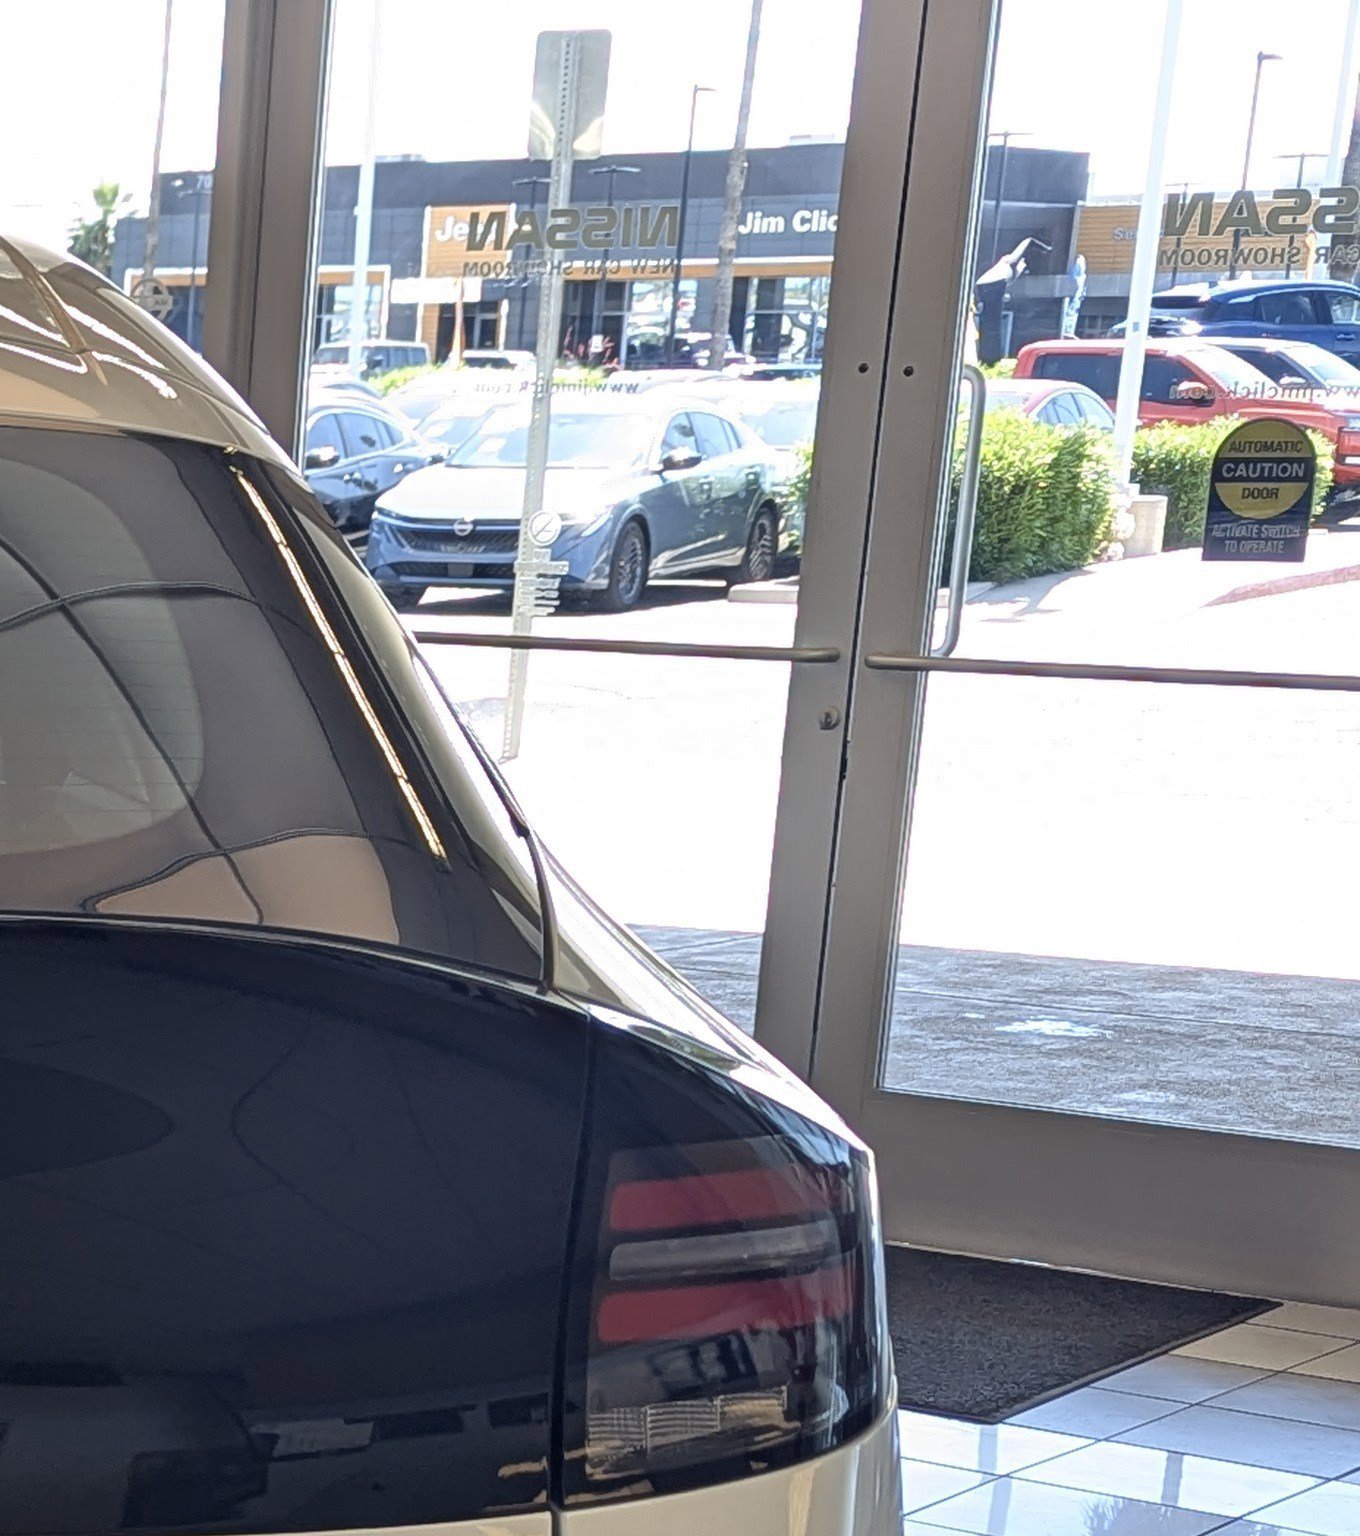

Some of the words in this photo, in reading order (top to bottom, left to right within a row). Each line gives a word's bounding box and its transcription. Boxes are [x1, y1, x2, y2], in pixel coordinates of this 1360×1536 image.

[738, 210, 785, 235] Jim
[1228, 440, 1304, 453] AUTOMATIC
[1221, 462, 1305, 478] CAUTION
[1241, 487, 1280, 500] DOOR
[1212, 523, 1258, 537] ACTIVATE
[1224, 540, 1237, 552] TO
[1240, 540, 1285, 554] OPERATE
